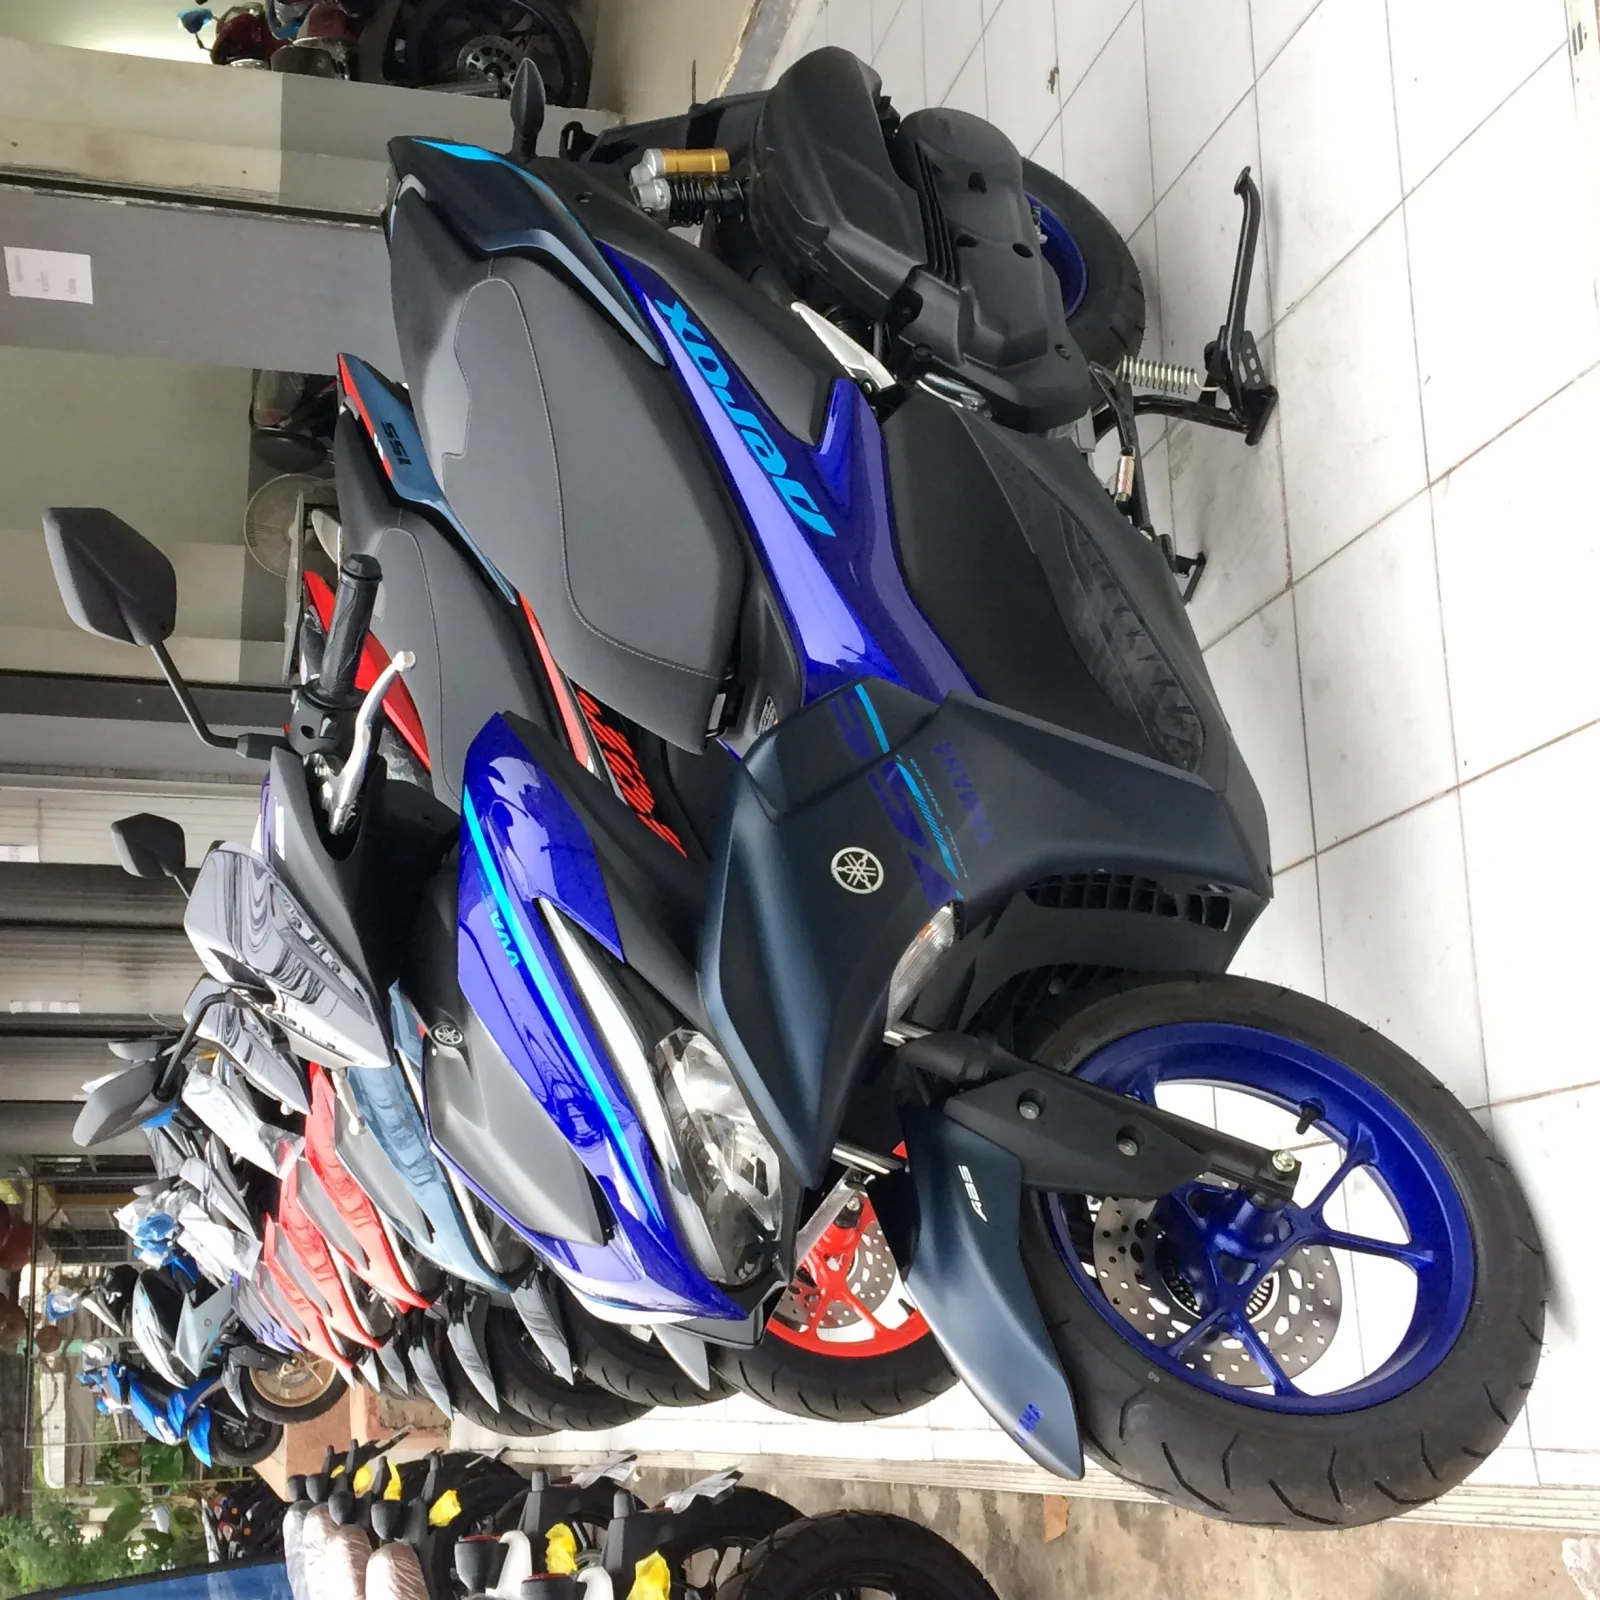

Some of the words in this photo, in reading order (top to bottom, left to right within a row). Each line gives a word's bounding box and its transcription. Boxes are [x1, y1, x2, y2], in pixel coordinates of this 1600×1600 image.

[380, 421, 412, 466] 155
[489, 910, 520, 969] VVA
[957, 1164, 989, 1223] ABS
